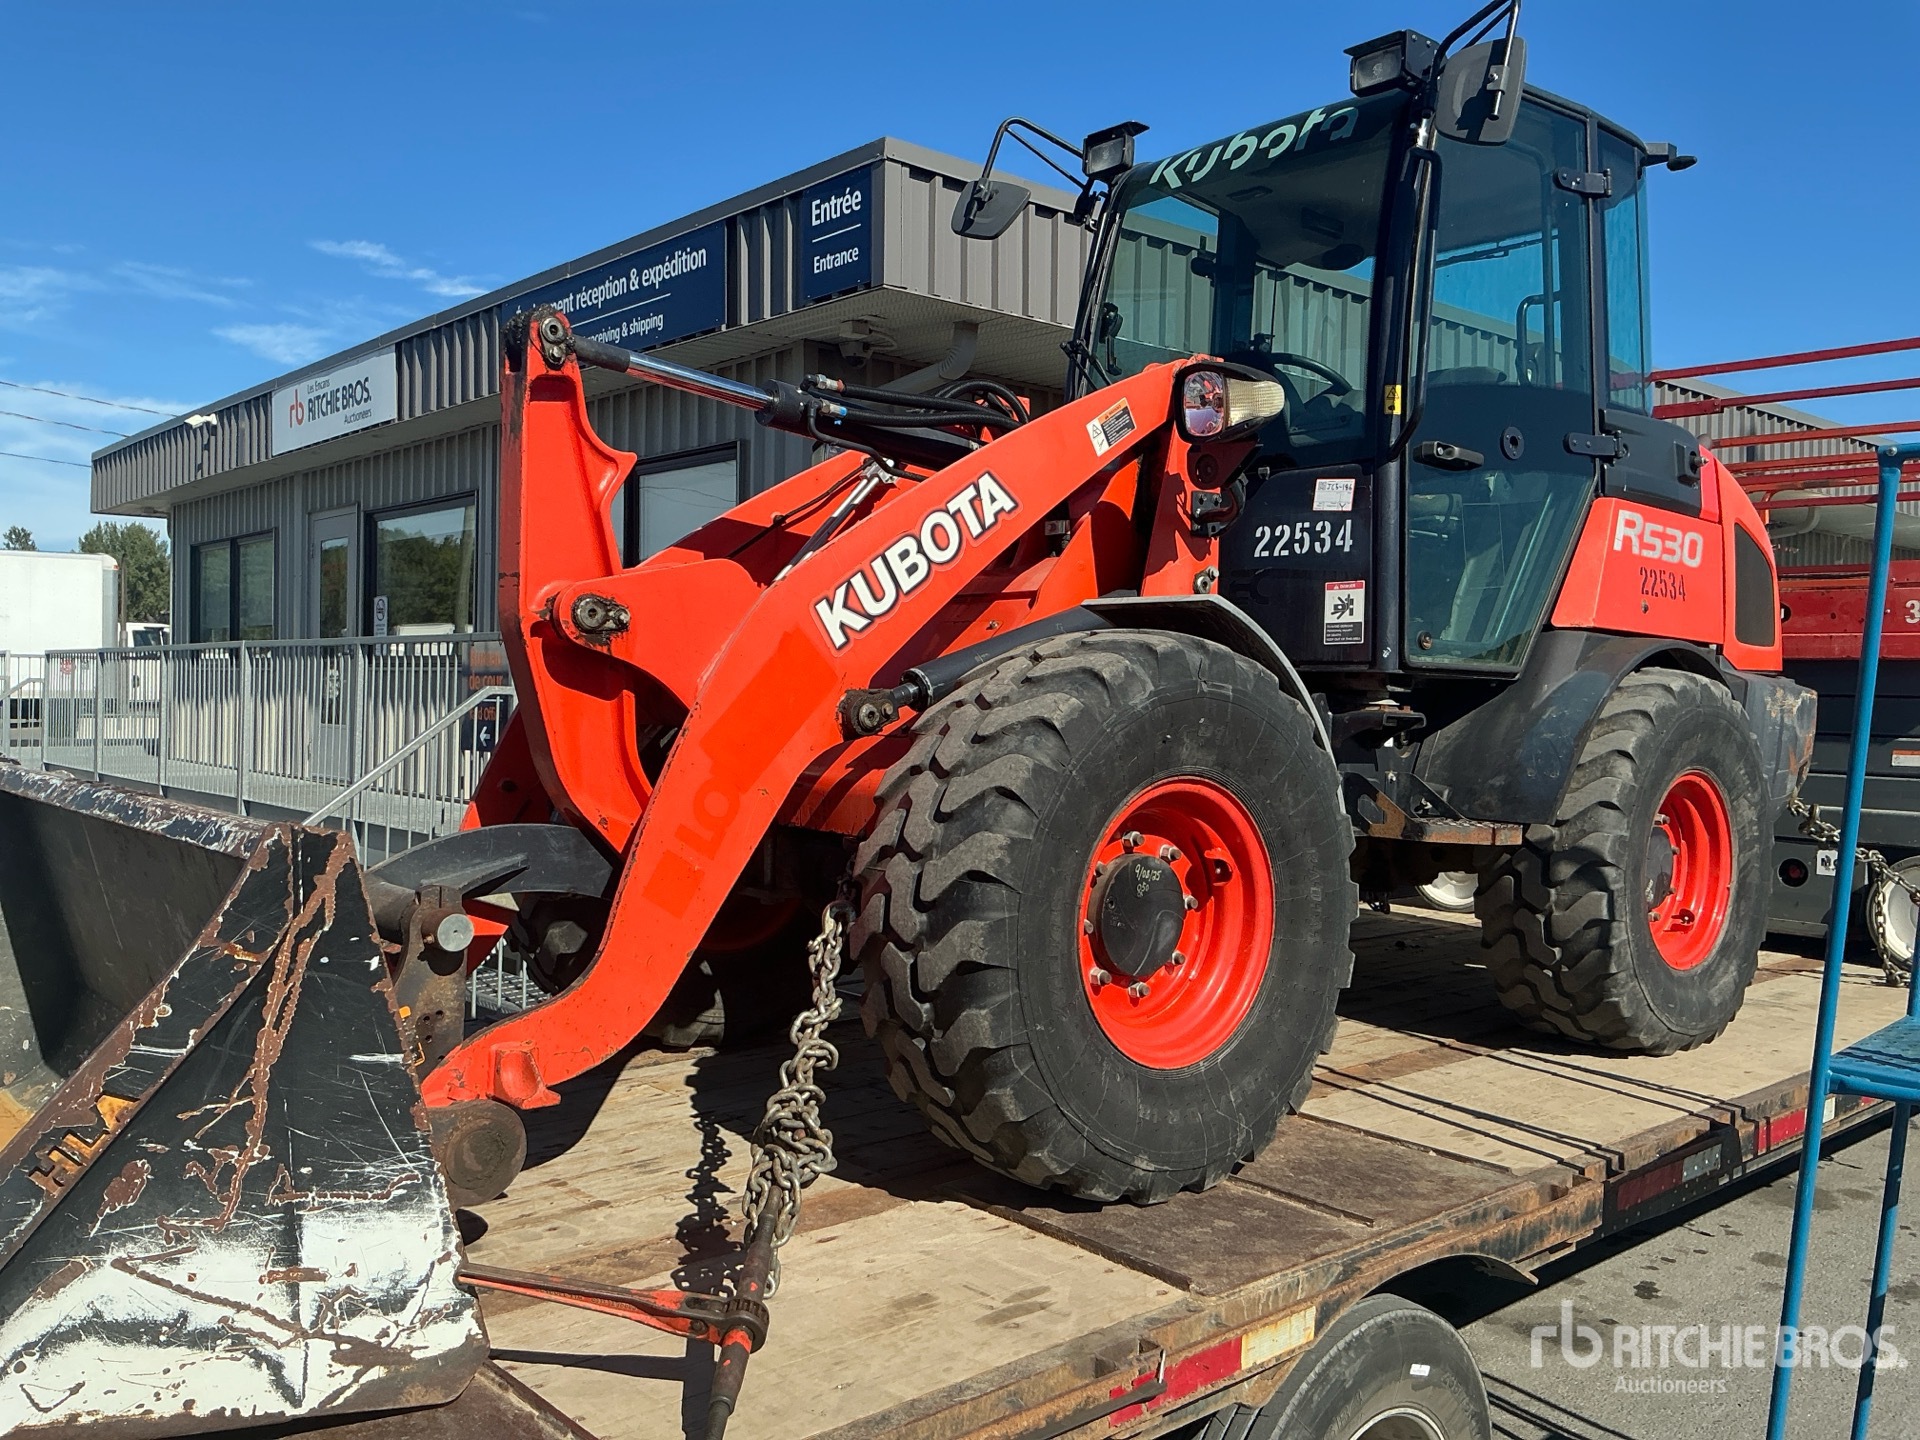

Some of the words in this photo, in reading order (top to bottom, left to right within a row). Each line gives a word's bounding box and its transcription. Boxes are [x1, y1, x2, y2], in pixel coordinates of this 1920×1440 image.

[811, 187, 862, 227] Entrée
[575, 275, 627, 309] réception
[629, 268, 640, 292] &
[641, 247, 707, 289] expédition
[813, 247, 859, 274] Entrance
[621, 322, 629, 336] &
[629, 313, 664, 335] shipping
[307, 387, 341, 422] RITCHIE
[341, 376, 372, 410] BROS.
[344, 409, 372, 425] Auctioneers
[1253, 518, 1354, 558] 22534
[1612, 508, 1704, 568] R530
[813, 470, 1019, 651] KUBOTA
[1639, 566, 1687, 602] 22534
